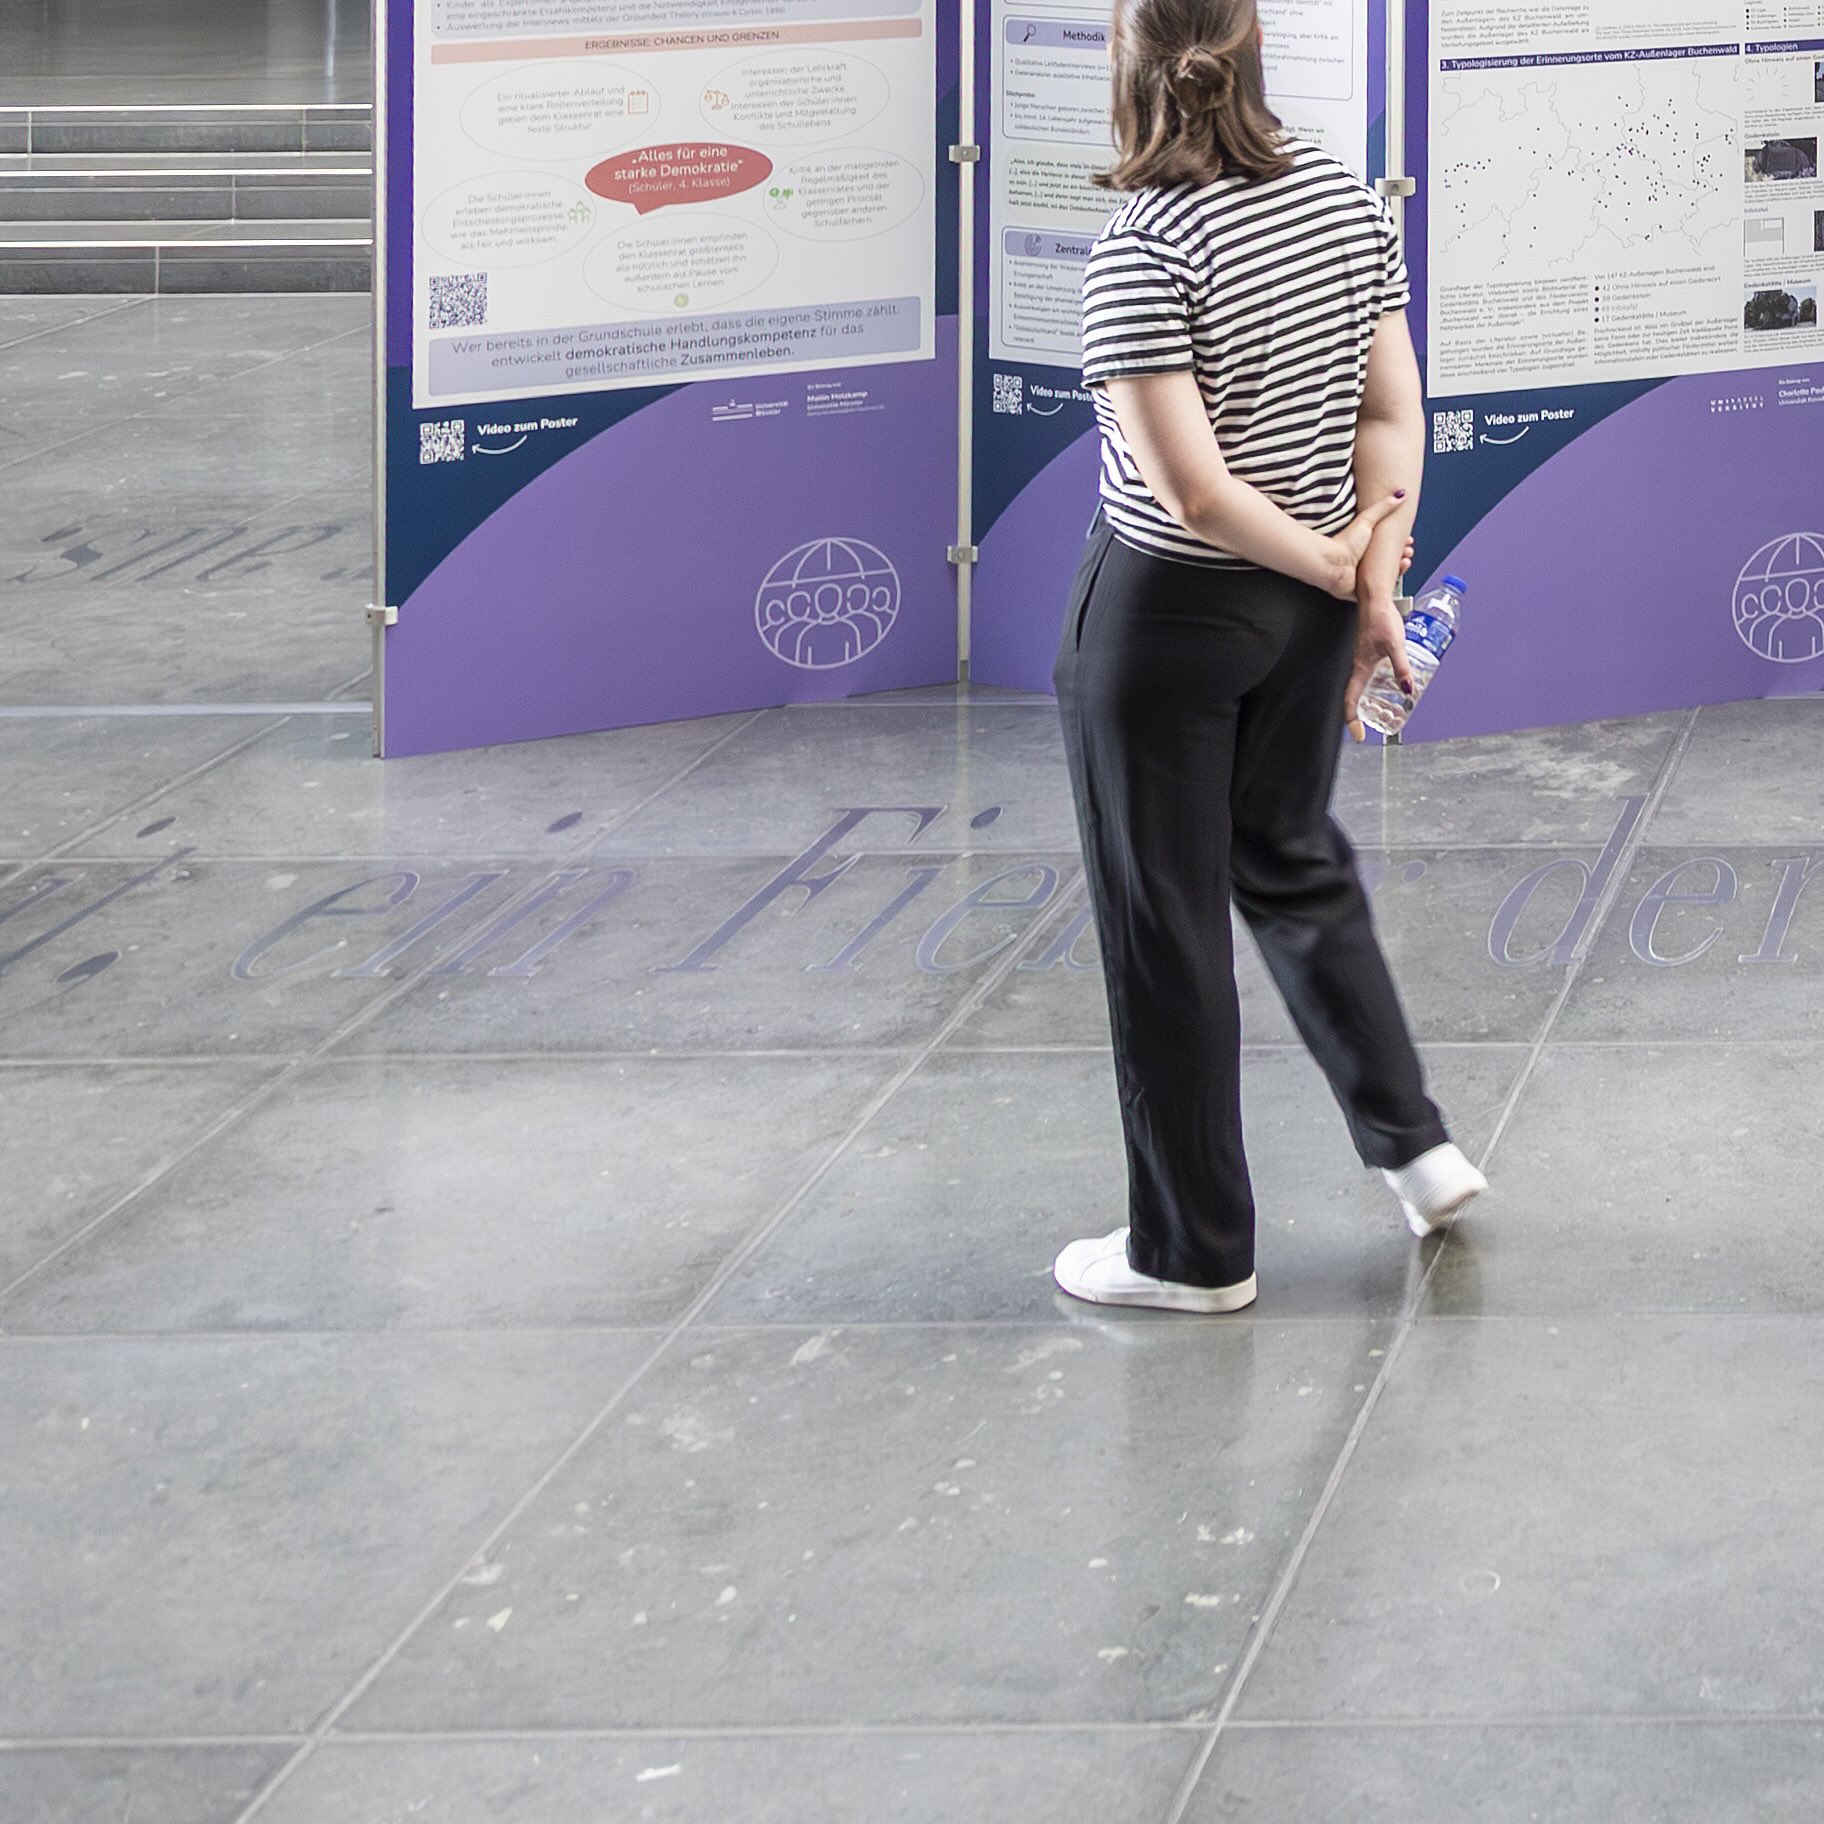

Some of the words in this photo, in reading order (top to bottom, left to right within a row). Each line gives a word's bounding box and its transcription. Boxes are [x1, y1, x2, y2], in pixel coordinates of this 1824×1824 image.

[1062, 29, 1105, 42] Methodik
[1440, 60, 1450, 70] 3.
[1451, 57, 1518, 70] Typologisierung
[1519, 56, 1534, 65] der
[1536, 53, 1602, 64] Erinnerungsorte
[1603, 52, 1623, 60] vom
[1623, 49, 1686, 59] KZ-Außenlager
[1687, 45, 1737, 56] Buchenwald
[676, 147, 695, 160] für
[699, 145, 727, 158] eine
[614, 166, 657, 180] starke
[491, 351, 561, 366] entwickelt
[565, 341, 666, 360] demokratische
[670, 328, 817, 350] Handlungskompetenz
[820, 325, 837, 337] für
[841, 323, 864, 335] das
[565, 356, 677, 378] gesellschaftliche
[476, 423, 511, 436] Video
[513, 421, 538, 432] zum
[540, 417, 578, 429] Poster
[1484, 413, 1515, 426] Video
[1517, 413, 1538, 423] zum
[1540, 409, 1574, 421] Poster
